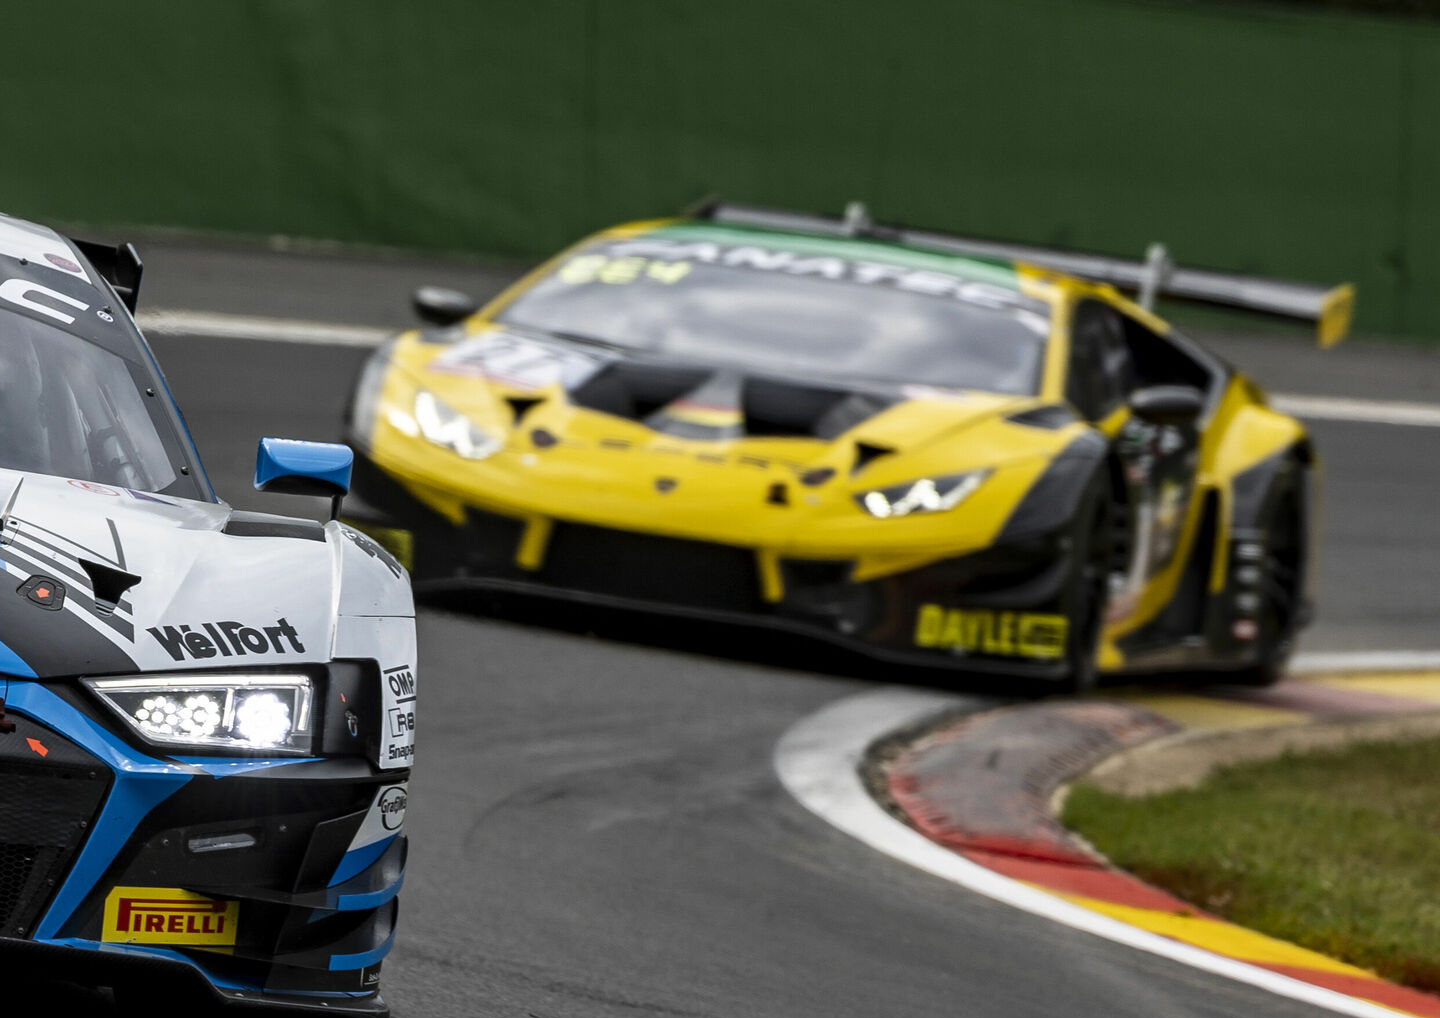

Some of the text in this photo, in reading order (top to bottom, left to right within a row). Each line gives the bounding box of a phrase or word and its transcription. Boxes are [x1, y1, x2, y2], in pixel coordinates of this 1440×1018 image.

[388, 671, 414, 697] OMP
[394, 711, 415, 733] R8
[116, 898, 228, 934] PIRELLI
